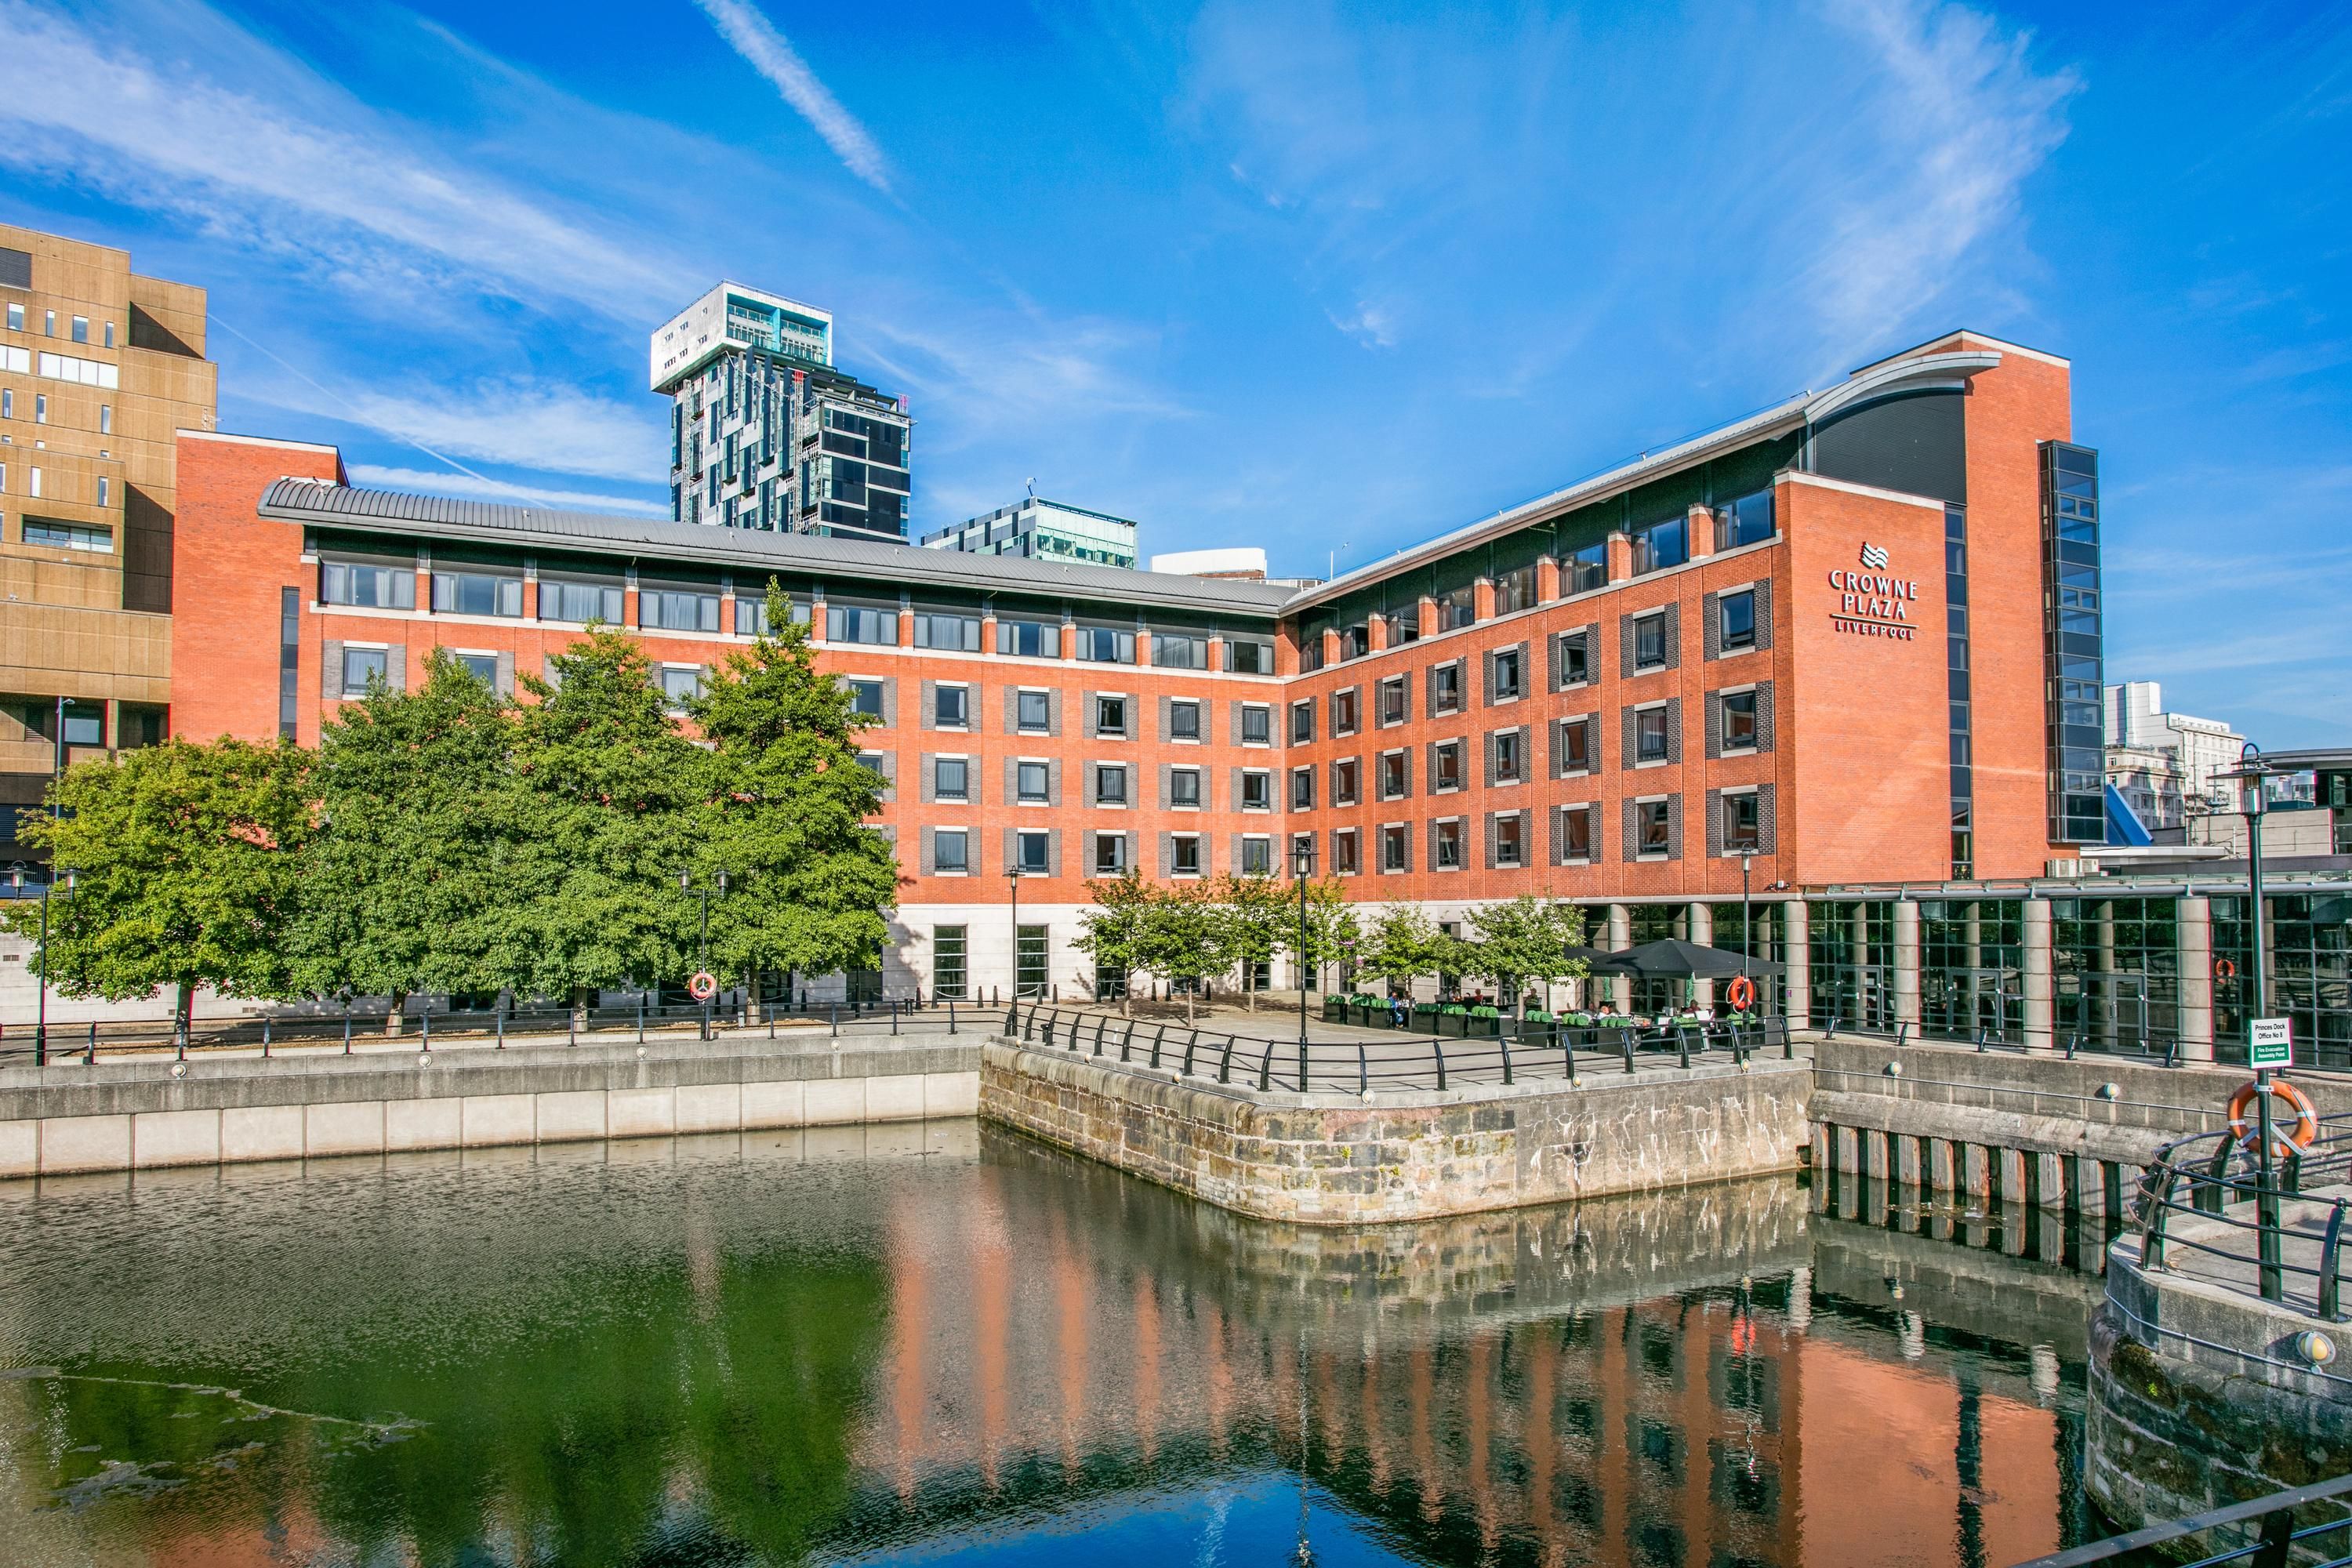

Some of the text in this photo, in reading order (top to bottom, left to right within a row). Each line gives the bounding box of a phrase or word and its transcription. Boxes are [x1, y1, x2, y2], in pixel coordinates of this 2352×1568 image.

[1829, 570, 1918, 601] CROWNE
[1842, 593, 1906, 619] PLAZA
[1836, 620, 1914, 640] LIVERPOOL
